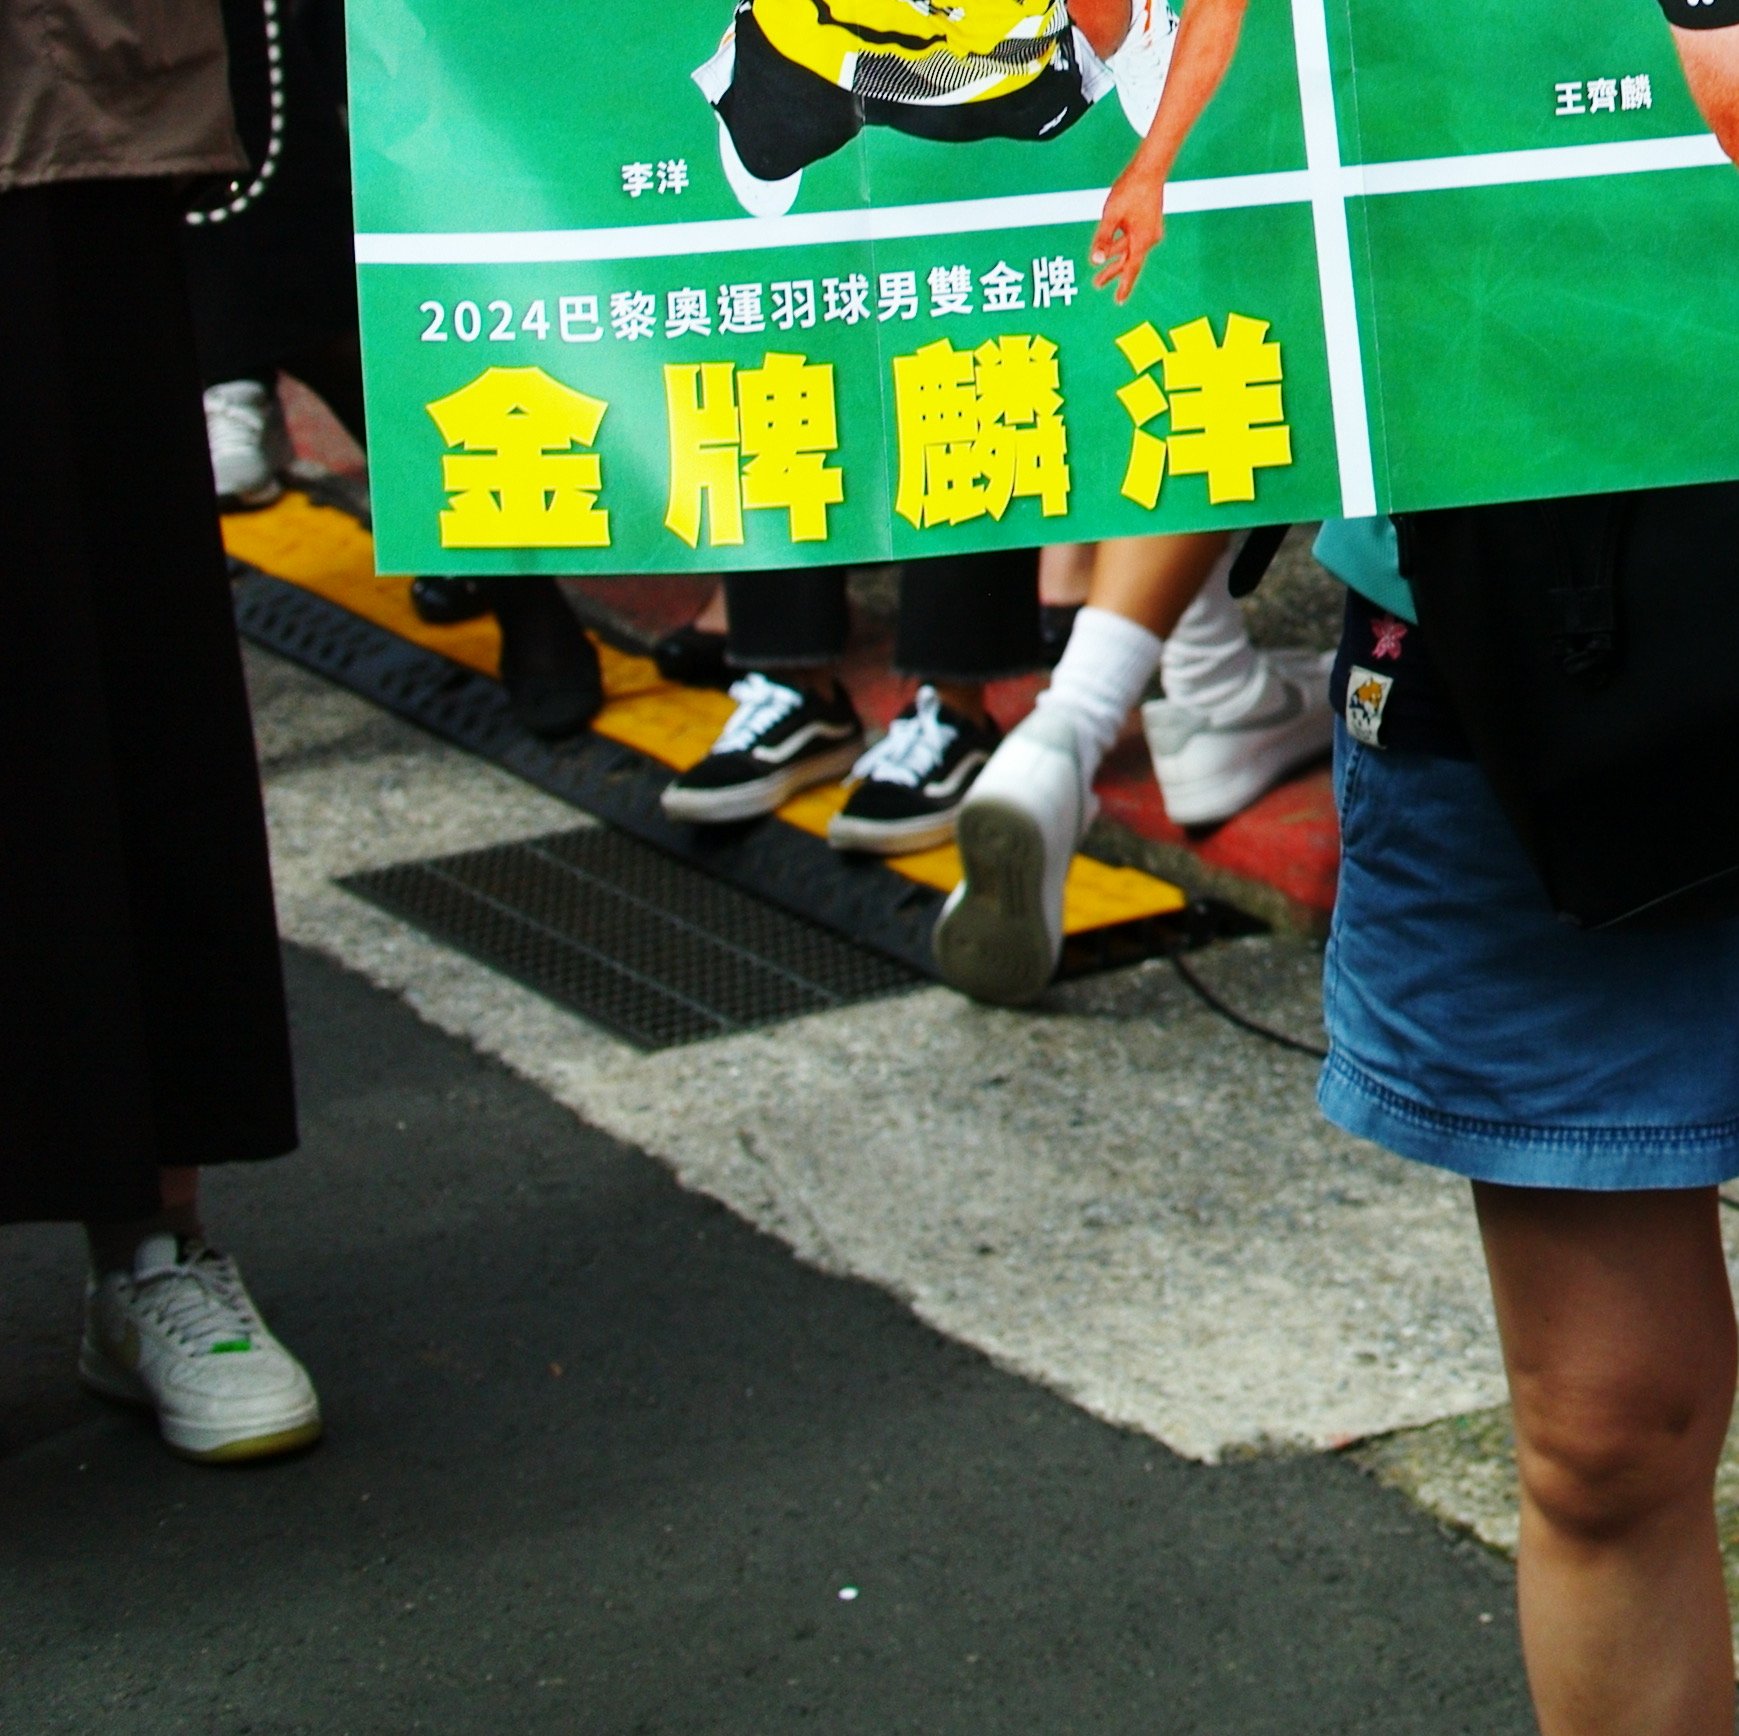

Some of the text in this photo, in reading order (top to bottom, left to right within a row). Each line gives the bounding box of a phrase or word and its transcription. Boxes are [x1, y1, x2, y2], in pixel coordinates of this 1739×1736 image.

[1555, 74, 1652, 115] 王齊麟
[621, 159, 690, 198] 李洋
[419, 255, 1080, 344] 2024巴黎奧運羽球男雙金牌
[426, 311, 1293, 549] 金牌麟洋
